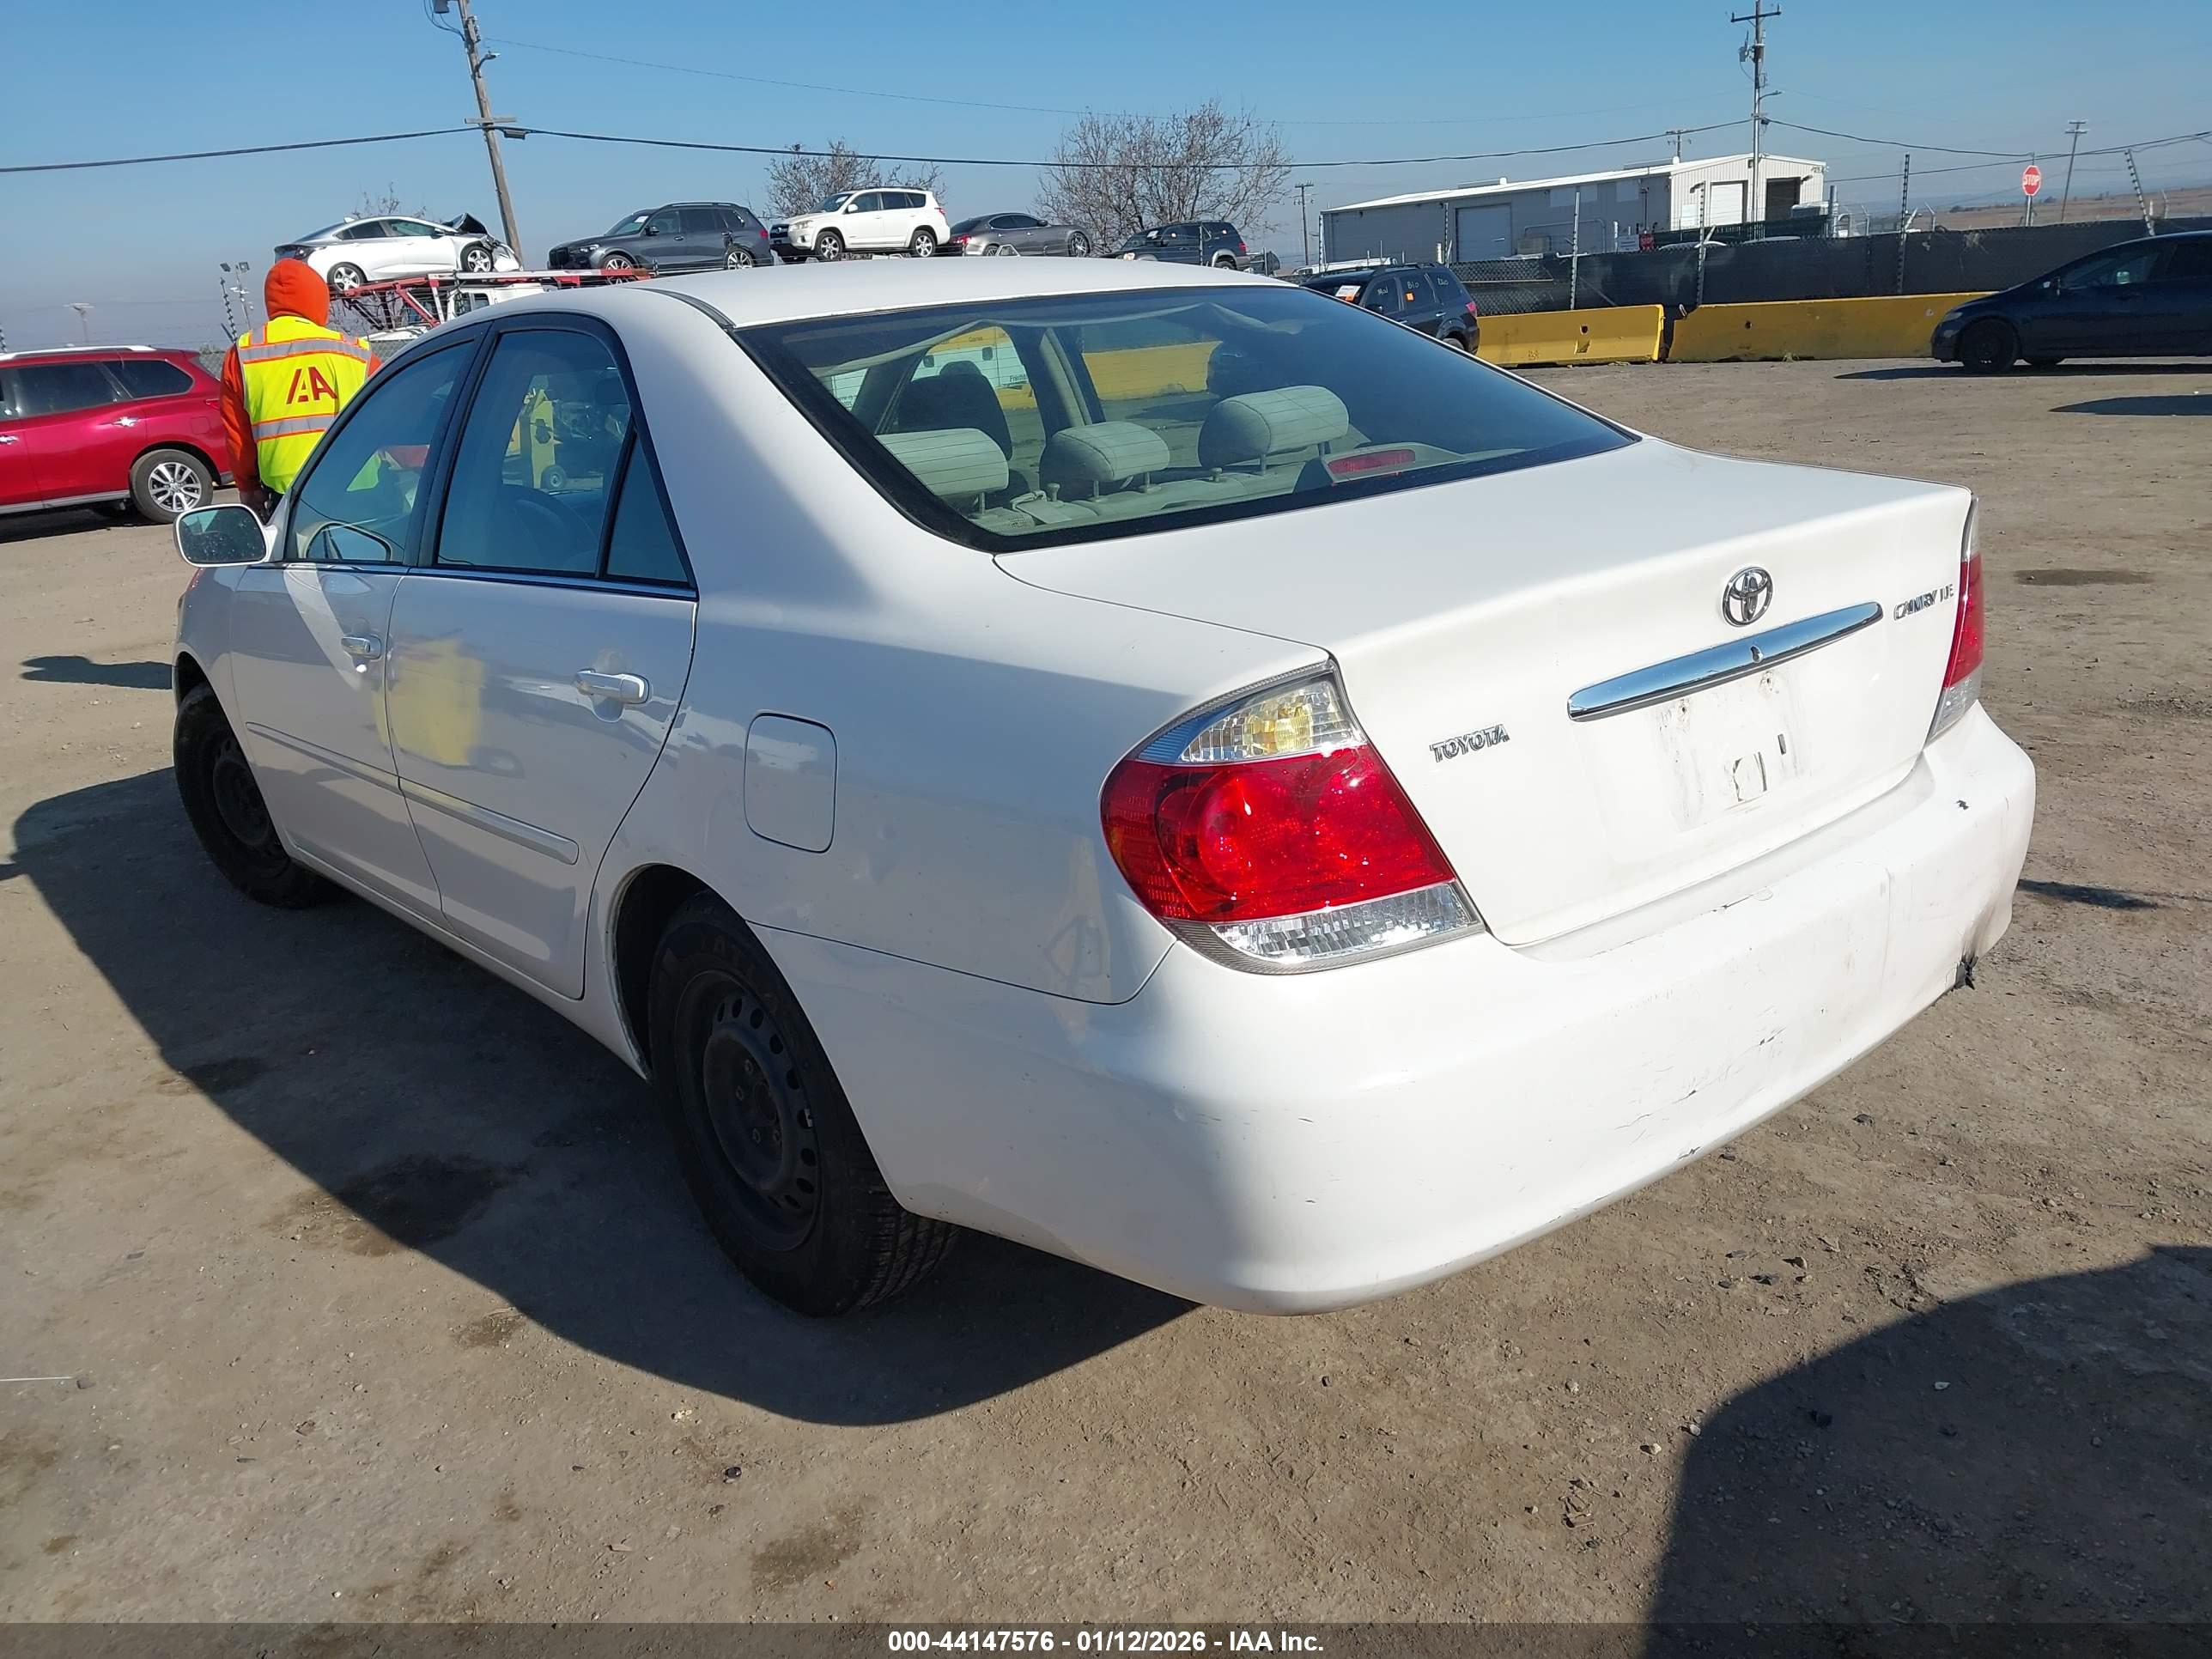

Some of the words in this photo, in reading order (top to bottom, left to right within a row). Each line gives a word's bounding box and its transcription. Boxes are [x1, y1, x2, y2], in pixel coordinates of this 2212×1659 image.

[2023, 174, 2040, 185] STOP
[1893, 589, 1938, 621] CAMRY
[1940, 584, 1954, 603] LE
[1429, 724, 1510, 763] TOYOTA
